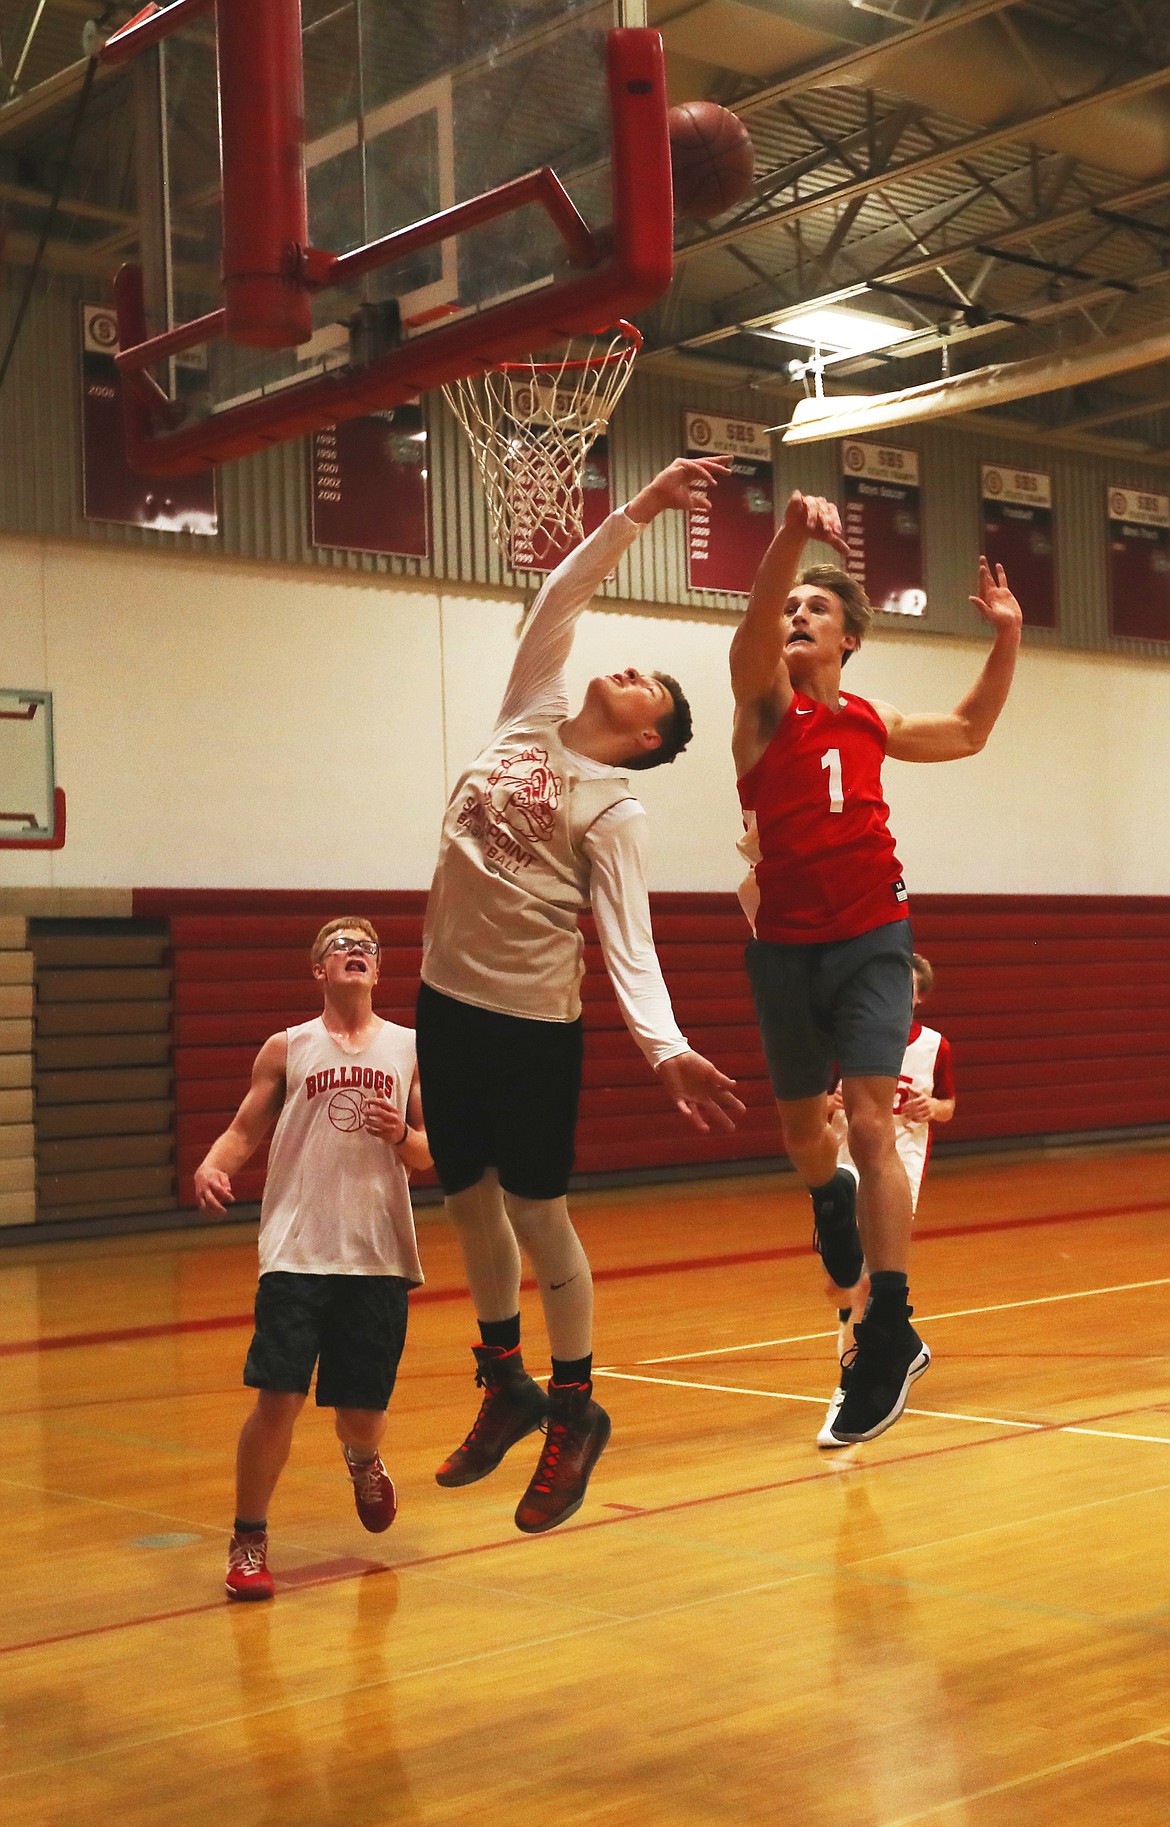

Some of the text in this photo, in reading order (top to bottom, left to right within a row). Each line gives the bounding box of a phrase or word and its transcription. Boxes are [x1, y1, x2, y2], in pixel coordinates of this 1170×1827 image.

[726, 423, 756, 444] SHS
[820, 748, 845, 814] 1
[305, 1065, 394, 1101] BULLDOGS
